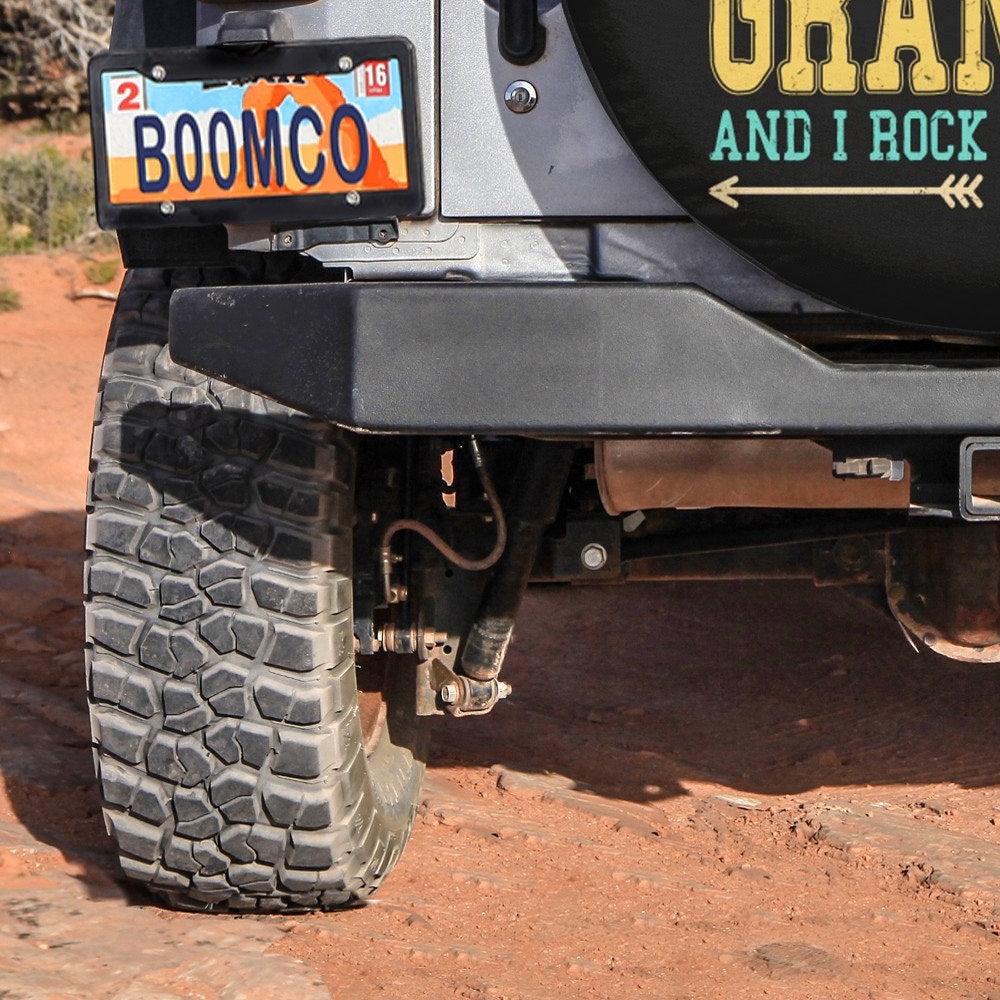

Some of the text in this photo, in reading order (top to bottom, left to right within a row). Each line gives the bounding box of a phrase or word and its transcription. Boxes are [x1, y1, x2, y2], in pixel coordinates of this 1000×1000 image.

[365, 63, 388, 87] 16
[117, 81, 141, 111] 2
[709, 109, 811, 162] AND
[832, 109, 848, 162] I
[869, 109, 988, 162] ROCK
